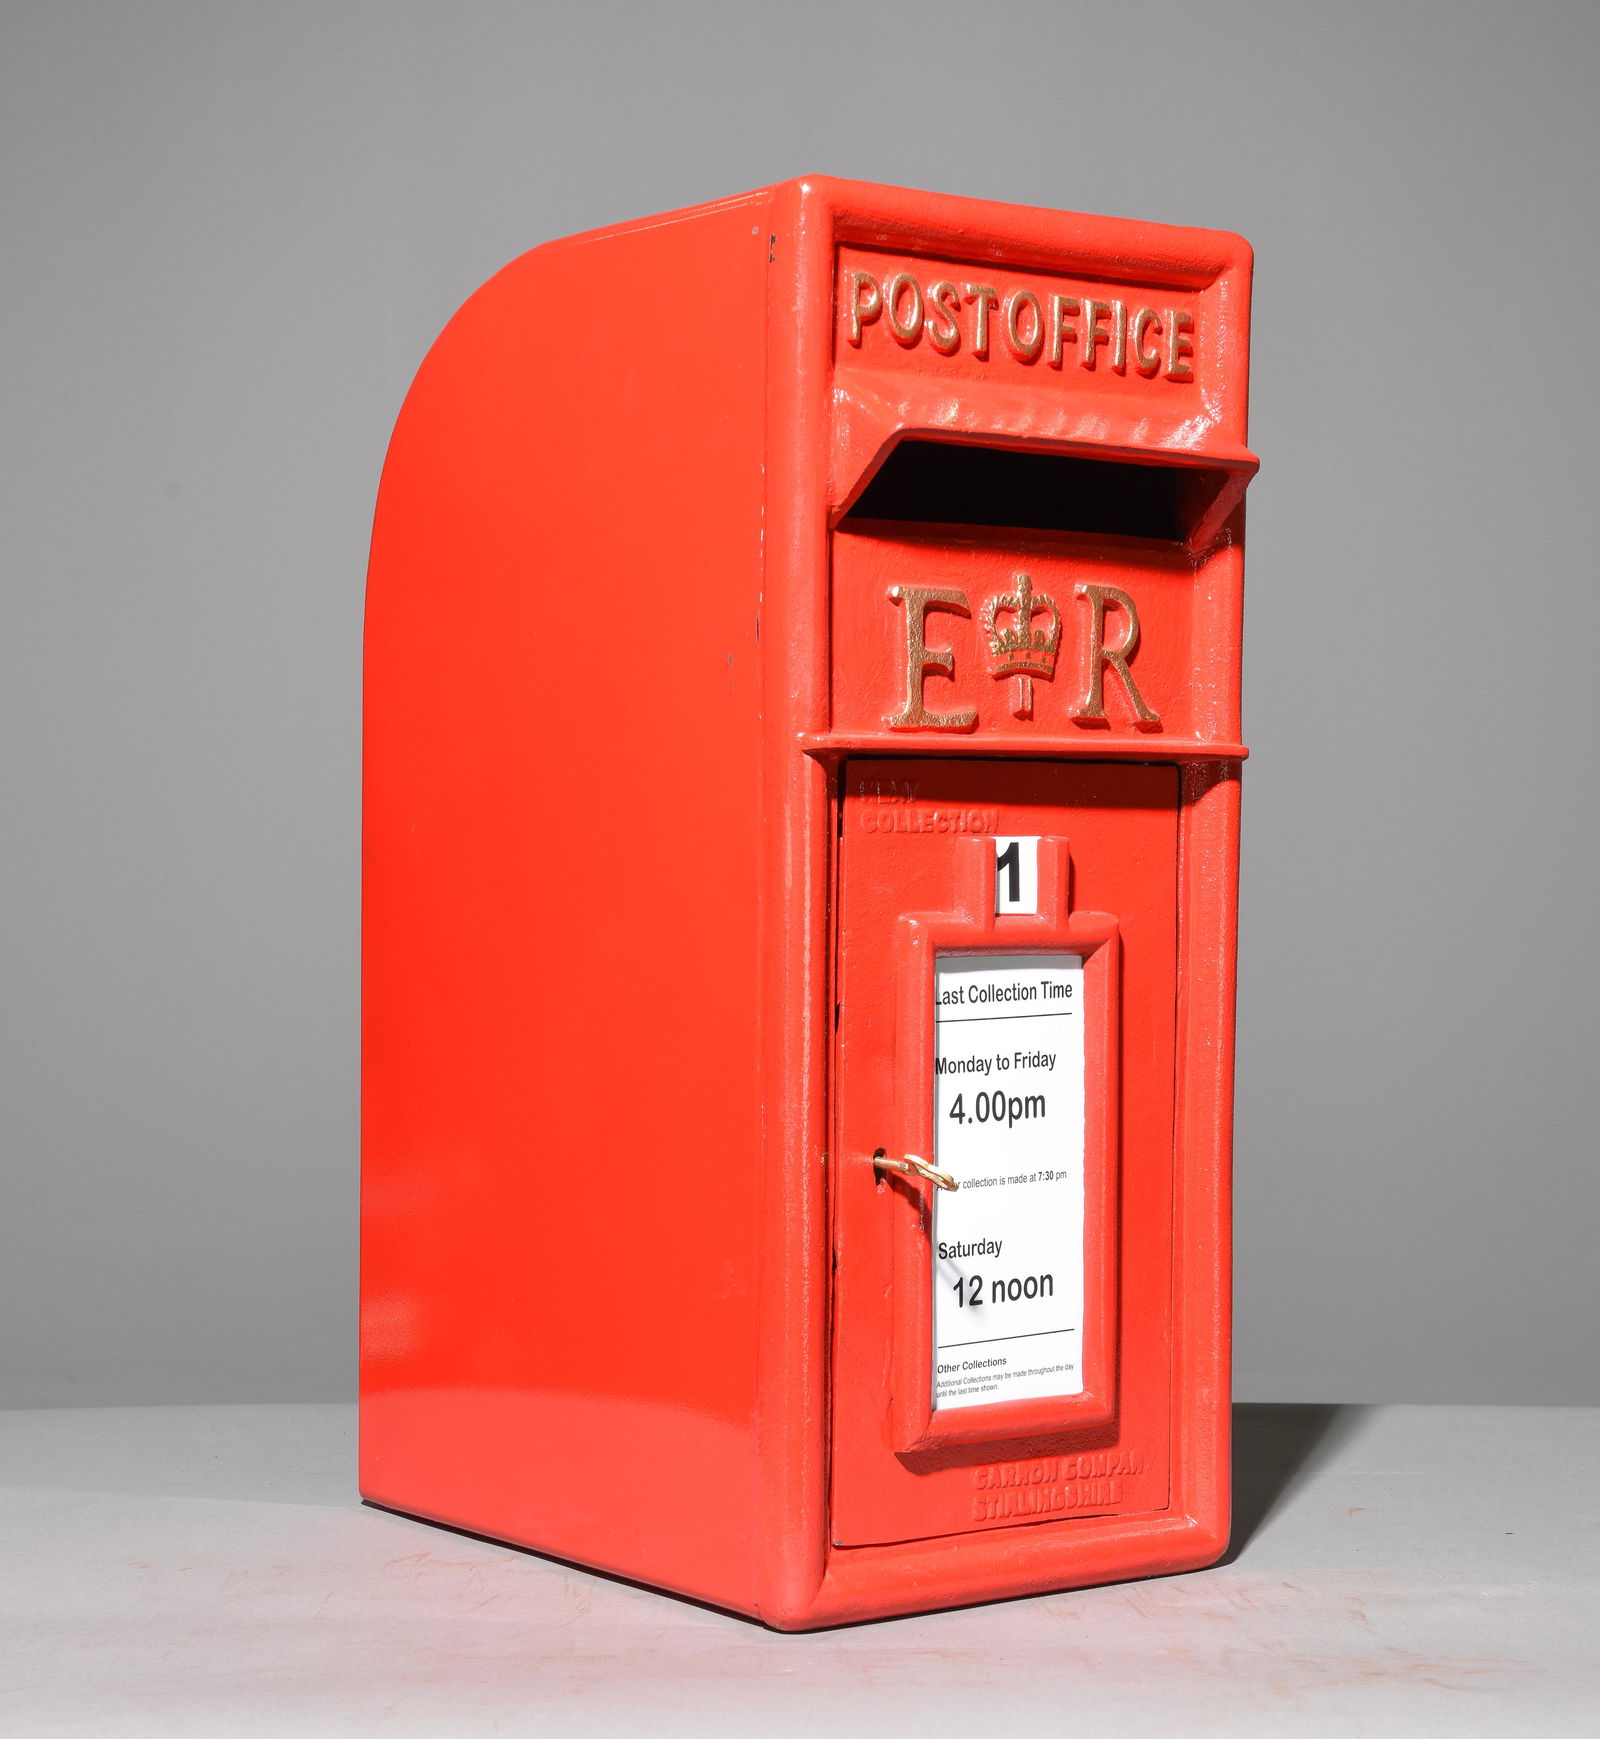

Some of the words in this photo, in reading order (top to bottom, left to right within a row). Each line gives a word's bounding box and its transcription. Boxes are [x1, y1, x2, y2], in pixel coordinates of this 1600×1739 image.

[883, 584, 978, 732] E
[1069, 583, 1163, 732] R
[997, 842, 1020, 902] 1
[936, 986, 965, 1005] ast
[968, 983, 1037, 1003] Collection
[1041, 981, 1073, 999] Time
[936, 1055, 992, 1076] Monday
[996, 1054, 1010, 1070] to
[1014, 1051, 1057, 1071] Friday
[949, 1090, 1046, 1128] 4.00pm
[962, 1177, 998, 1189] collection
[999, 1176, 1006, 1185] is
[1007, 1174, 1028, 1185] made
[1029, 1173, 1037, 1183] at
[1038, 1170, 1054, 1181] 7:30
[1055, 1171, 1067, 1182] pm
[938, 1238, 1003, 1260] Saturday
[953, 1275, 983, 1308] 12
[992, 1274, 1053, 1304] noon
[936, 1380, 963, 1388] Additional
[963, 1375, 992, 1385] Collections
[1012, 1370, 1027, 1378] made
[1027, 1366, 1055, 1376] throughout
[937, 1364, 961, 1374] Other
[962, 1357, 1007, 1370] Collections
[948, 1388, 957, 1396] the
[958, 1387, 968, 1395] last
